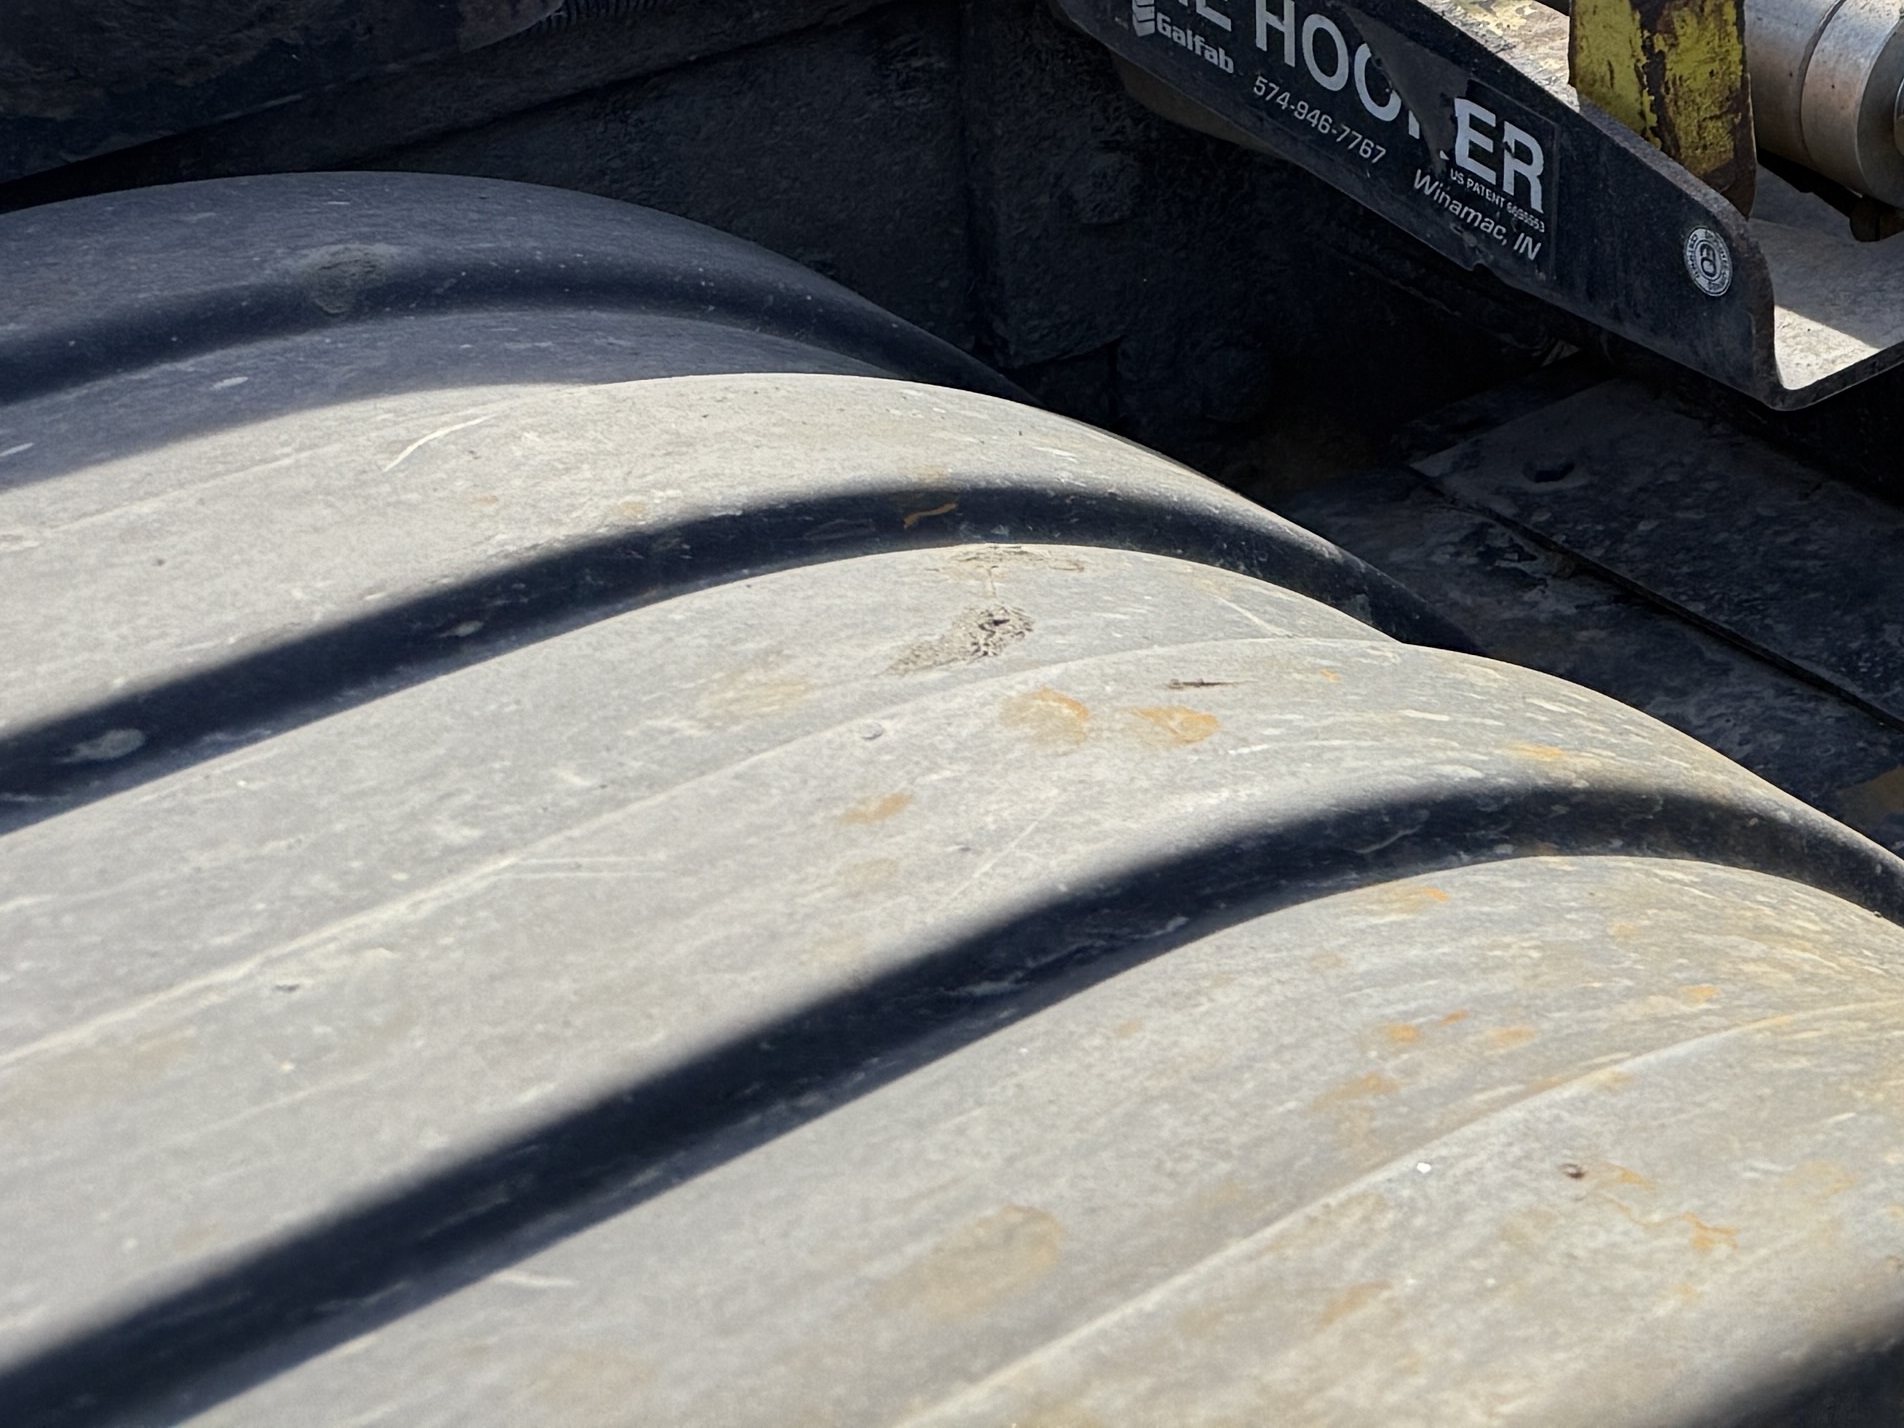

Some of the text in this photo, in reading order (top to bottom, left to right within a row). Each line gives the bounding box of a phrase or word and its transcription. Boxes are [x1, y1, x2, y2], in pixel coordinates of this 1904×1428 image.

[1156, 11, 1235, 74] Galfab
[1252, 76, 1387, 165] 574-946-7767
[1413, 168, 1542, 261] Winamac, IN
[1450, 167, 1465, 186] US
[1466, 178, 1505, 209] PATENT
